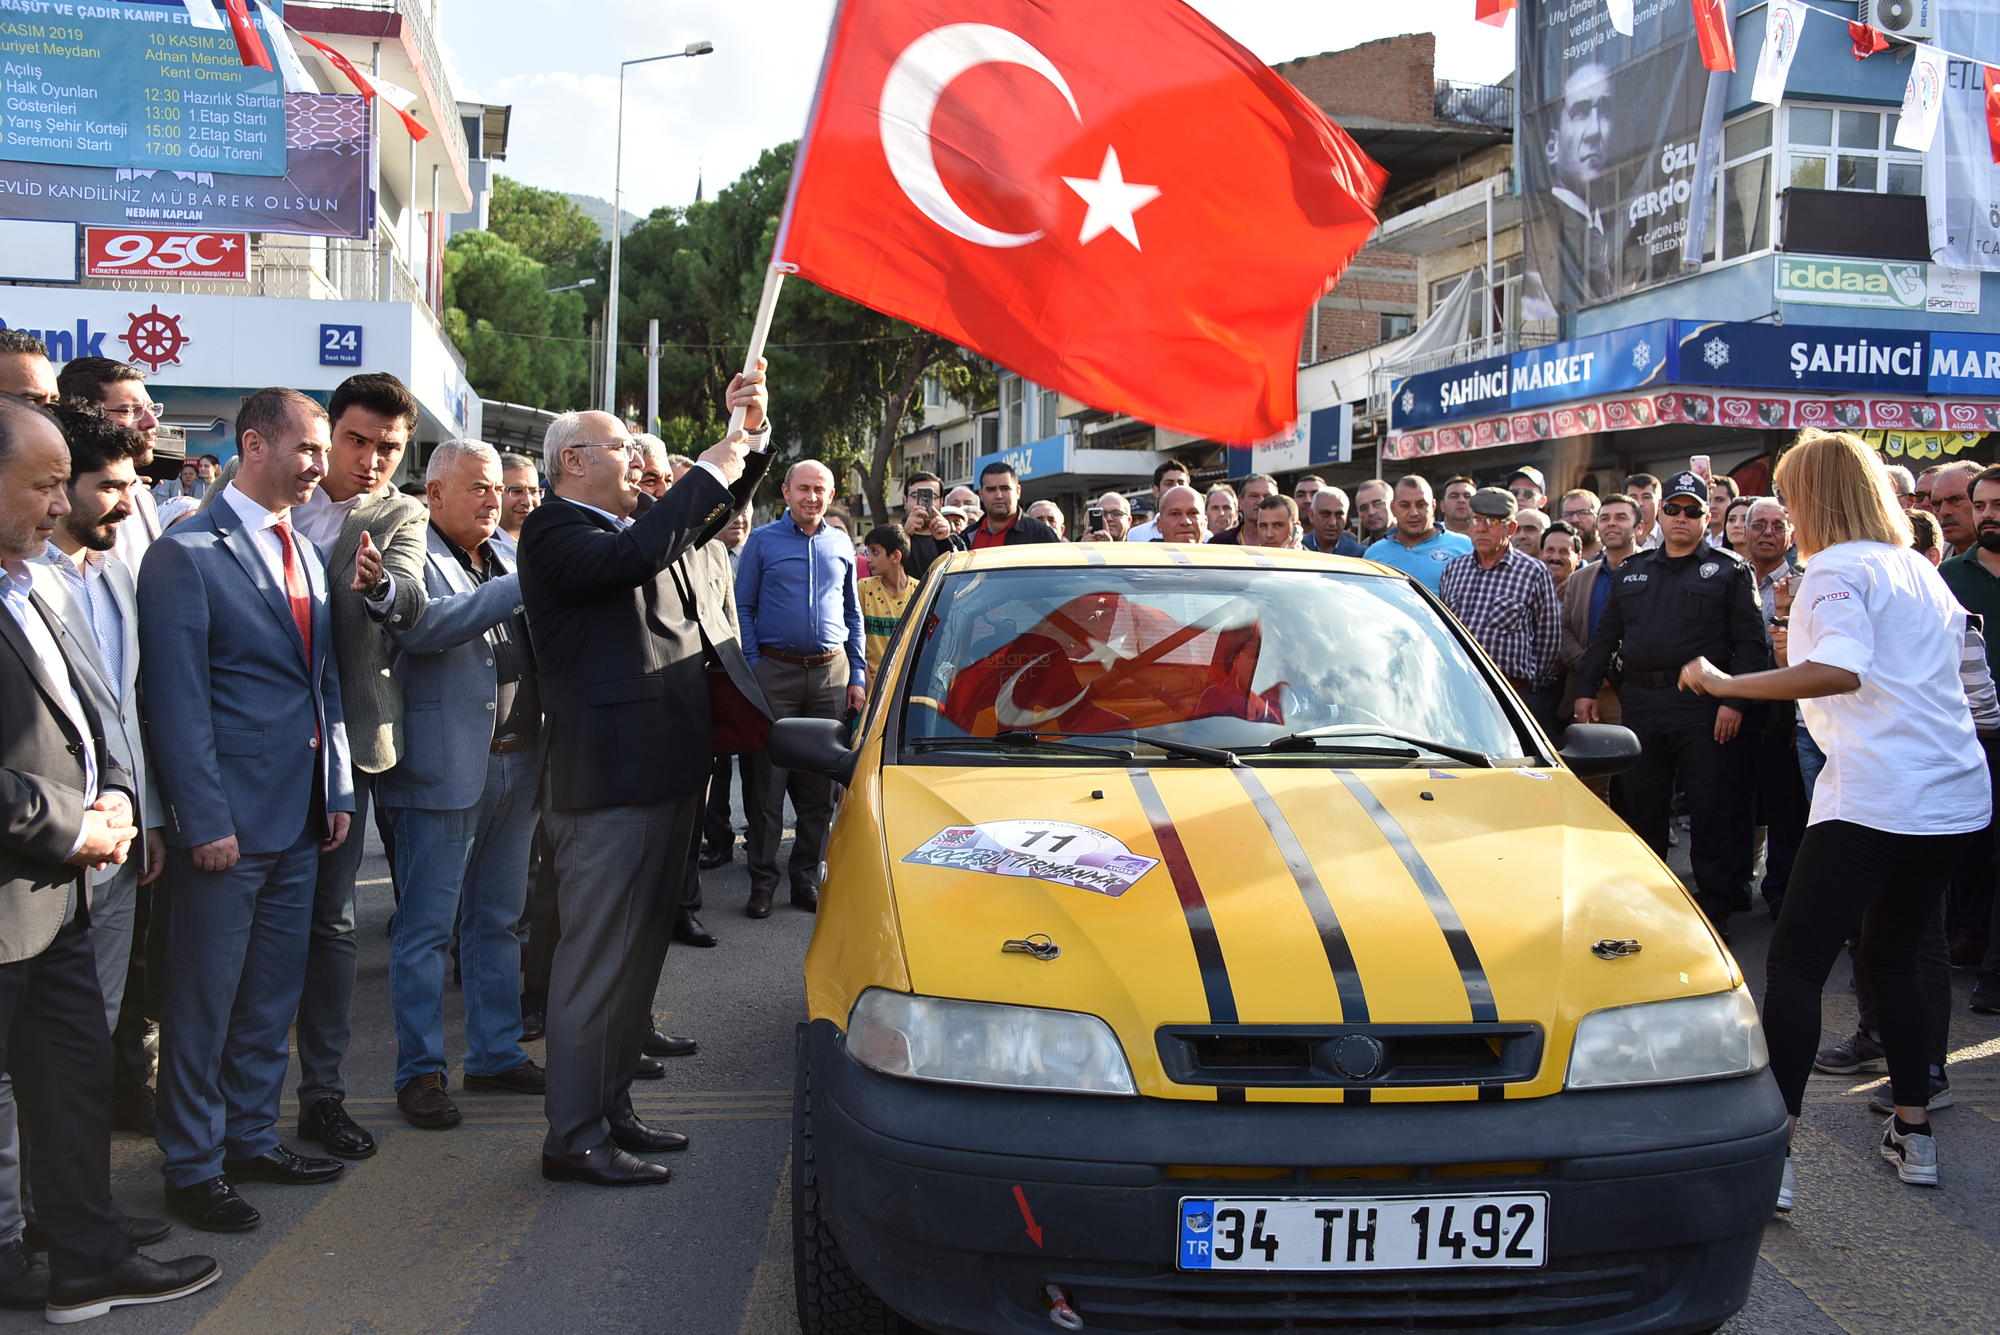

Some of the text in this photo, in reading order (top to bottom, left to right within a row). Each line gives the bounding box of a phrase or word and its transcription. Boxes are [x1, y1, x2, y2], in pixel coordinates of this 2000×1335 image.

[0, 0, 50, 14] RAŞÜT
[53, 3, 73, 16] VE
[77, 5, 121, 19] ÇADIR
[124, 8, 168, 23] KAMPI
[1549, 10, 1568, 27] Ulu
[1920, 0, 1928, 28] BEK
[49, 26, 83, 41] 2019
[149, 33, 236, 50] 10 KASIM 20
[0, 40, 101, 59] uriyet Meydanı
[145, 49, 243, 66] Adnan Mender
[4, 61, 43, 80] Açılış
[160, 65, 242, 82] Kent Ormanı
[6, 79, 98, 99] Halk Oyunları
[144, 87, 285, 109] 12:30 Hazırlık Startları
[6, 97, 77, 115] Gösterileri
[6, 114, 128, 138] Yarış Şehir Korteji
[145, 106, 267, 127] 13:00 1.Etap Startı
[7, 131, 112, 152] Seremoni Startı
[145, 124, 267, 144] 15:00 2.Etap Startı
[146, 142, 263, 160] 17:00 Ödül Töreni
[48, 183, 141, 203] KANDİLİNİZ
[151, 189, 255, 209] MÜBAREK
[264, 195, 338, 213] OLSUN
[125, 205, 203, 221] NEDİM KAPLAN
[1782, 262, 1888, 293] iddaa
[325, 329, 357, 350] 24
[1791, 339, 1922, 379] ŞAHİNCİ
[1440, 351, 1594, 413] ŞAHİNCİ MARKET
[984, 653, 1050, 668] sparco
[1020, 830, 1077, 853] 11
[1214, 1203, 1535, 1263] 34 TH 1492
[1186, 1240, 1210, 1256] TR
